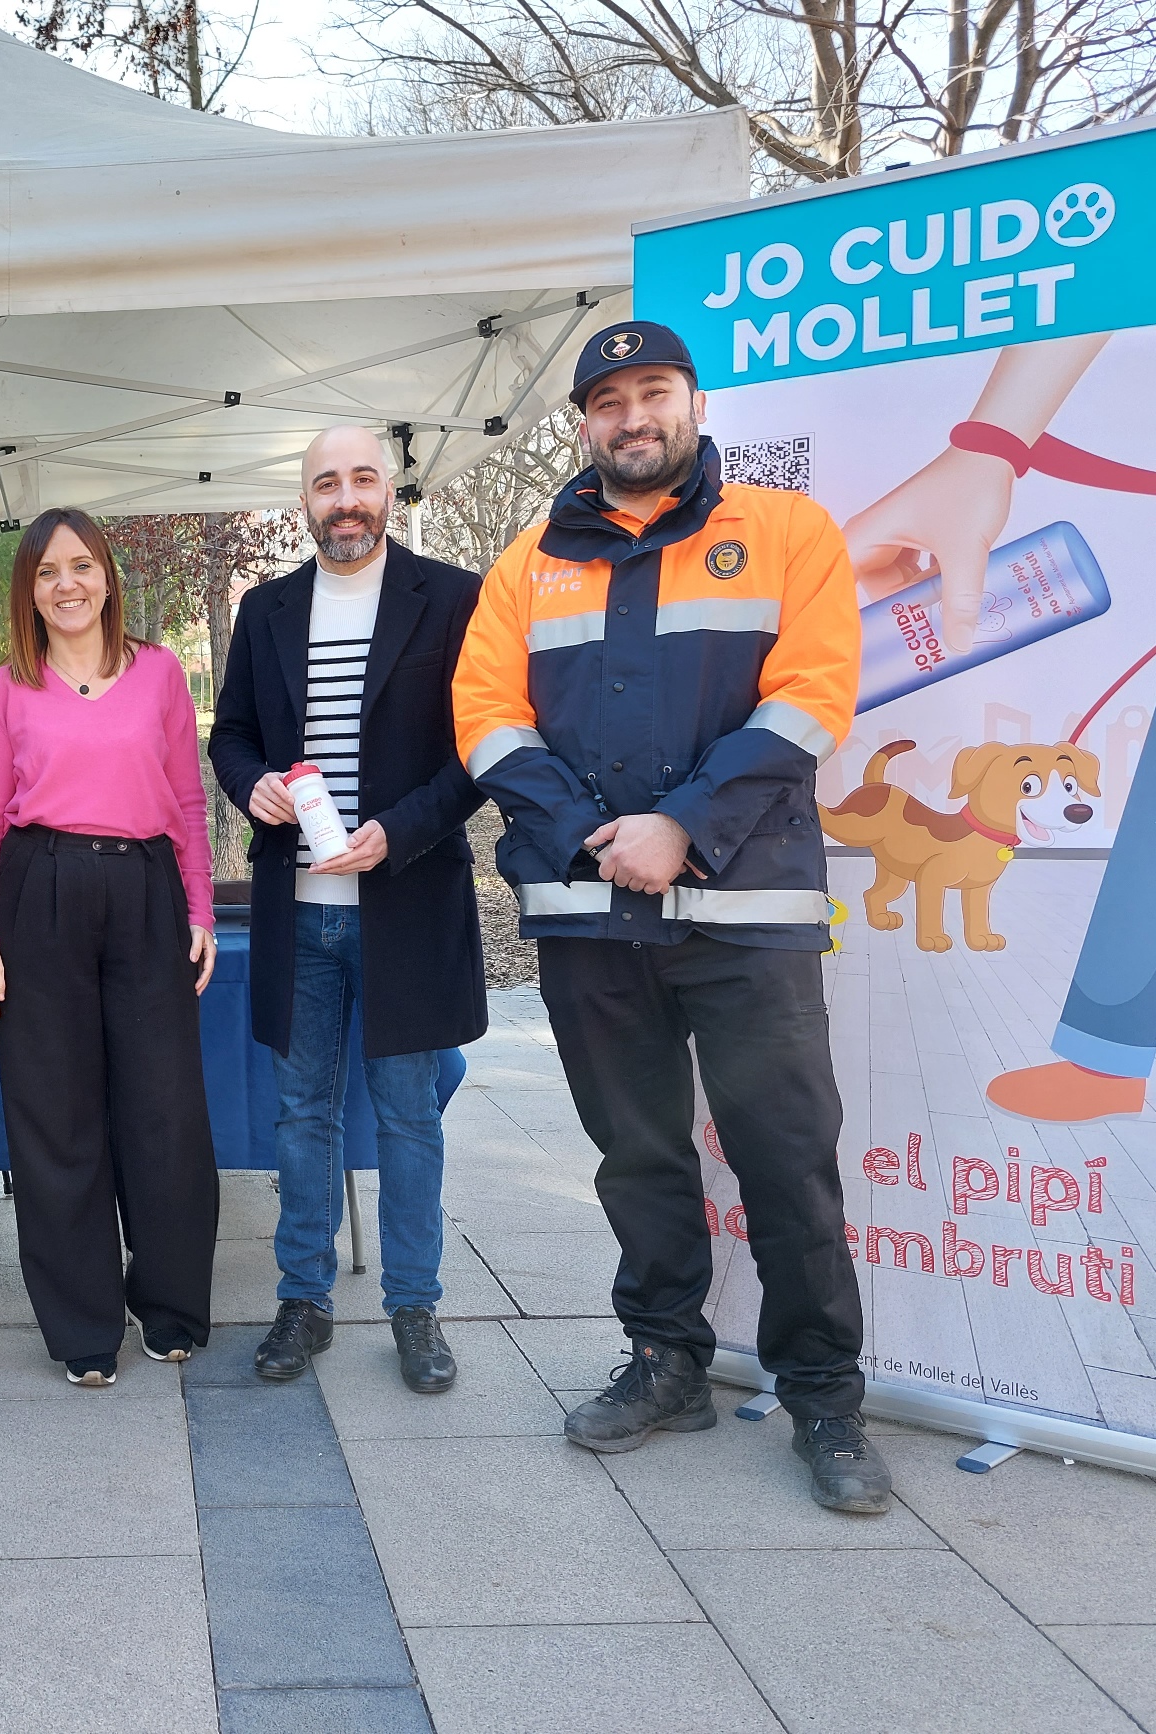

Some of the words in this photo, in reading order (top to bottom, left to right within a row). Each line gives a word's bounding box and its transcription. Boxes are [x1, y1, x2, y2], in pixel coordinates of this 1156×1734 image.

[703, 242, 804, 309] JO
[733, 263, 1075, 374] MOLLET
[1018, 584, 1031, 594] el
[1022, 550, 1054, 600] l'embruti
[1027, 596, 1042, 618] Que
[1049, 600, 1062, 614] no
[907, 604, 946, 664] MOLLET
[914, 654, 933, 672] JO
[862, 1132, 927, 1192] el
[952, 1146, 1107, 1226] pipí
[884, 1357, 903, 1372] de
[909, 1360, 956, 1385] Mollet
[960, 1373, 984, 1390] del
[990, 1377, 1039, 1401] Vallès
